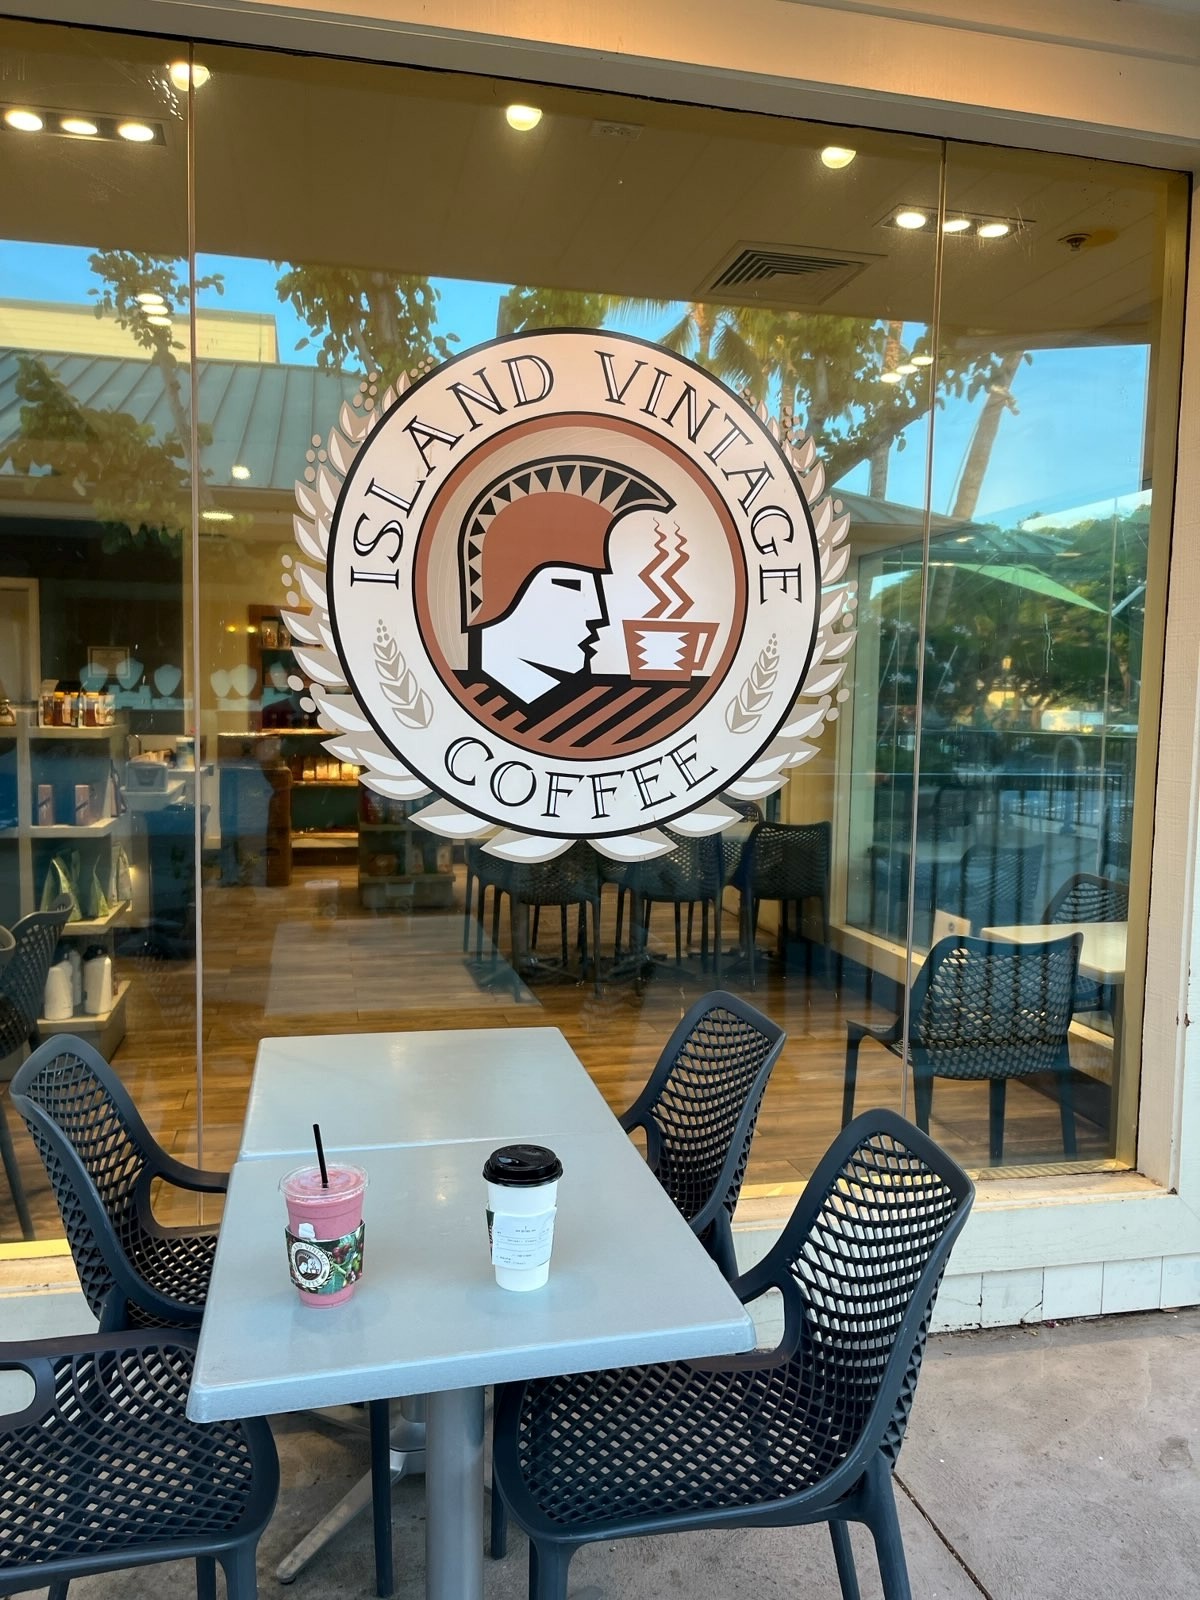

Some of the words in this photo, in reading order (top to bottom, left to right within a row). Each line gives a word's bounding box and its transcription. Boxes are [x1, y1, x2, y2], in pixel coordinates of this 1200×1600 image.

[350, 354, 554, 590] ISLAND
[594, 351, 803, 605] VINTAGE
[445, 734, 718, 820] COFFEE
